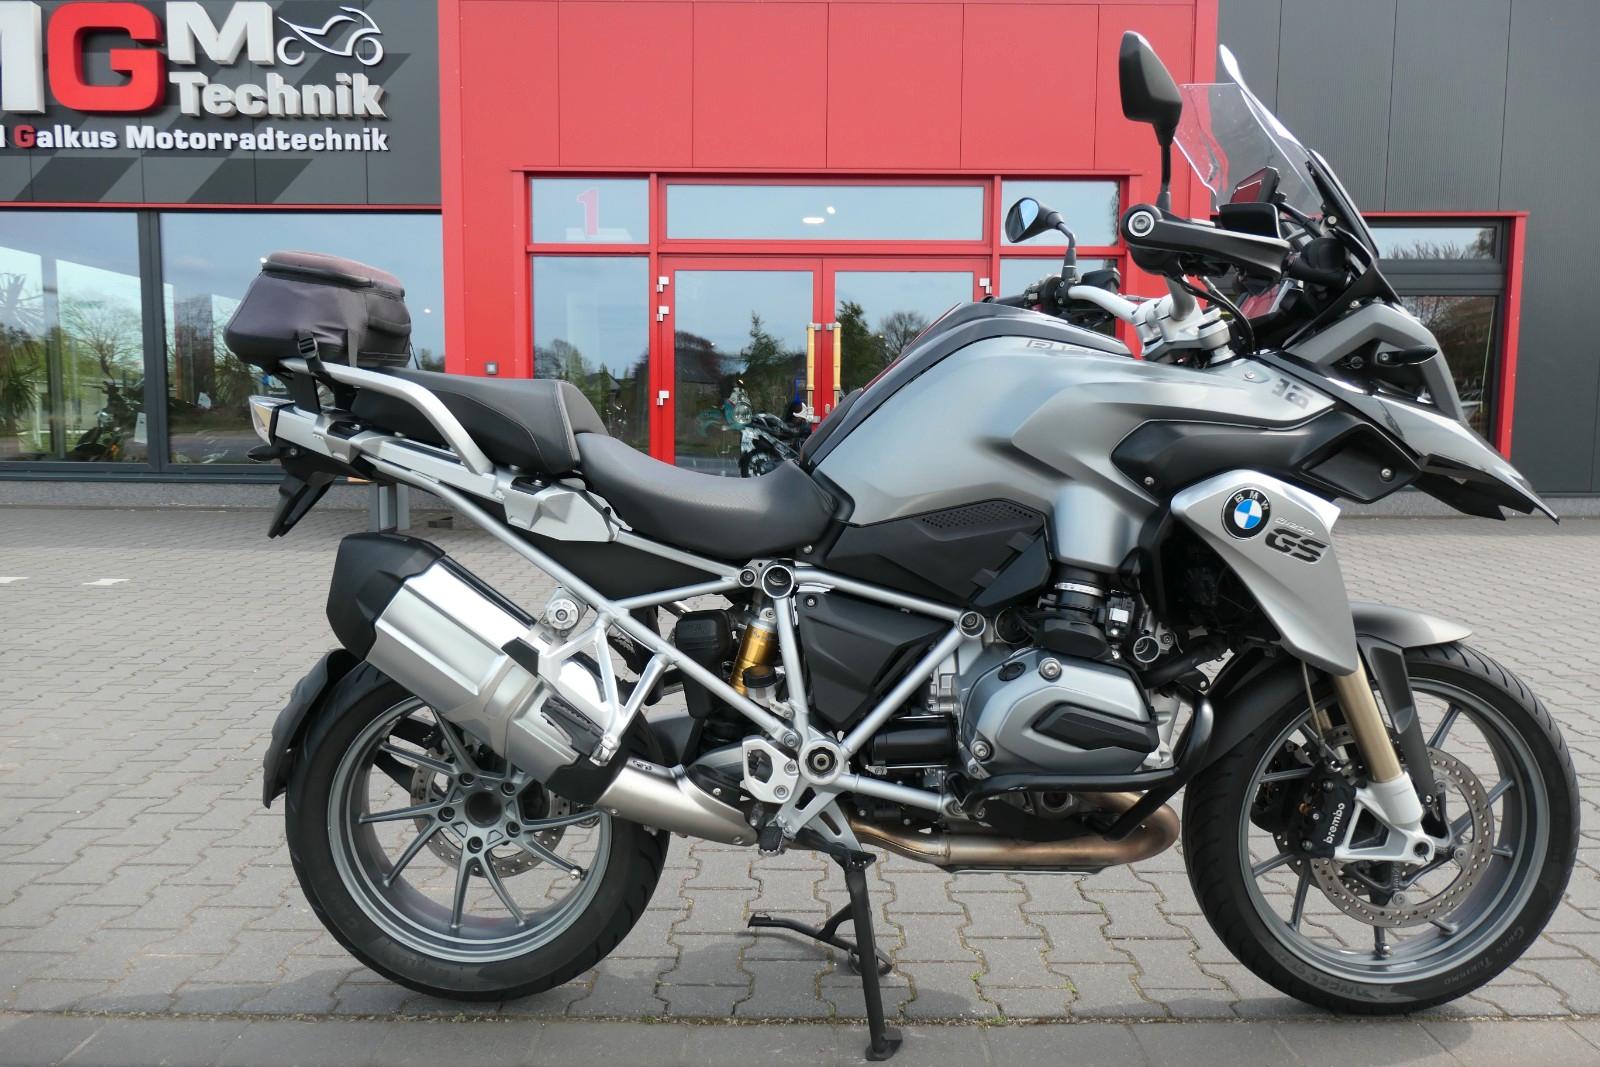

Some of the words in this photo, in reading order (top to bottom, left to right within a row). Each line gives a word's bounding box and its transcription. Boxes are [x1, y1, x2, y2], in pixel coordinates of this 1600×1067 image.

[169, 71, 387, 119] Technik
[14, 124, 117, 149] Galkus
[126, 125, 390, 151] Motorradtechnik
[1234, 491, 1269, 510] BMW
[1265, 528, 1327, 563] GS
[1323, 802, 1345, 844] brembo
